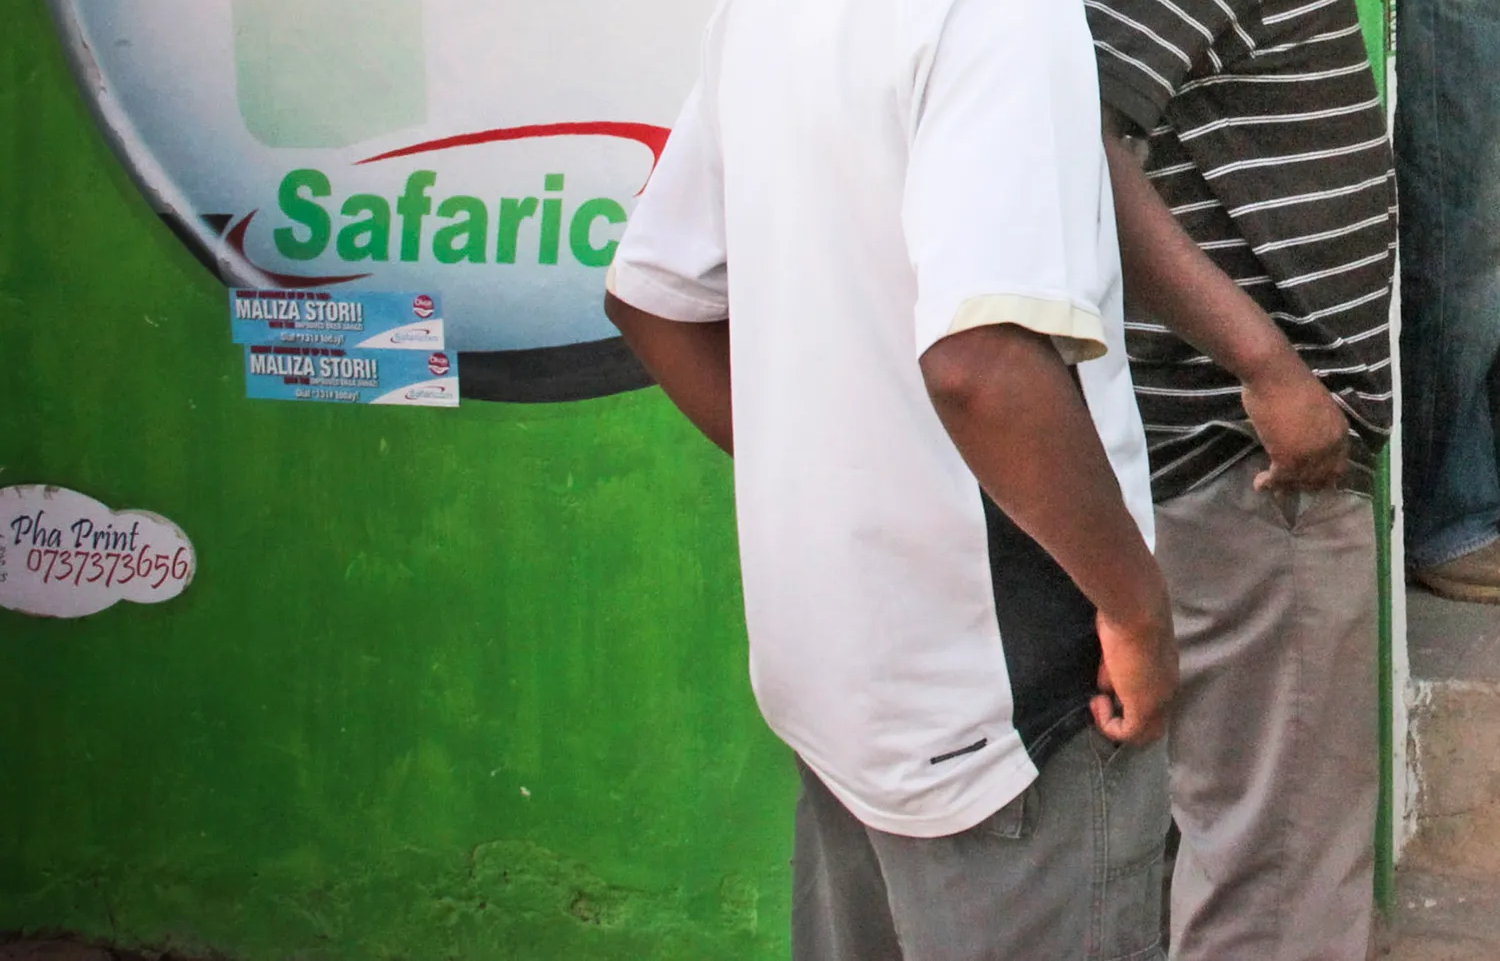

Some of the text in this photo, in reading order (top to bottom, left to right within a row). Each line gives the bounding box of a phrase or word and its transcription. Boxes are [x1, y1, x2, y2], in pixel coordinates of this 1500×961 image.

[273, 168, 628, 268] Safaric
[235, 298, 364, 323] MALIZA STORI!
[250, 354, 379, 380] MALIZA STORI!
[10, 510, 139, 552] Pha Print
[27, 545, 189, 589] 0737373656
